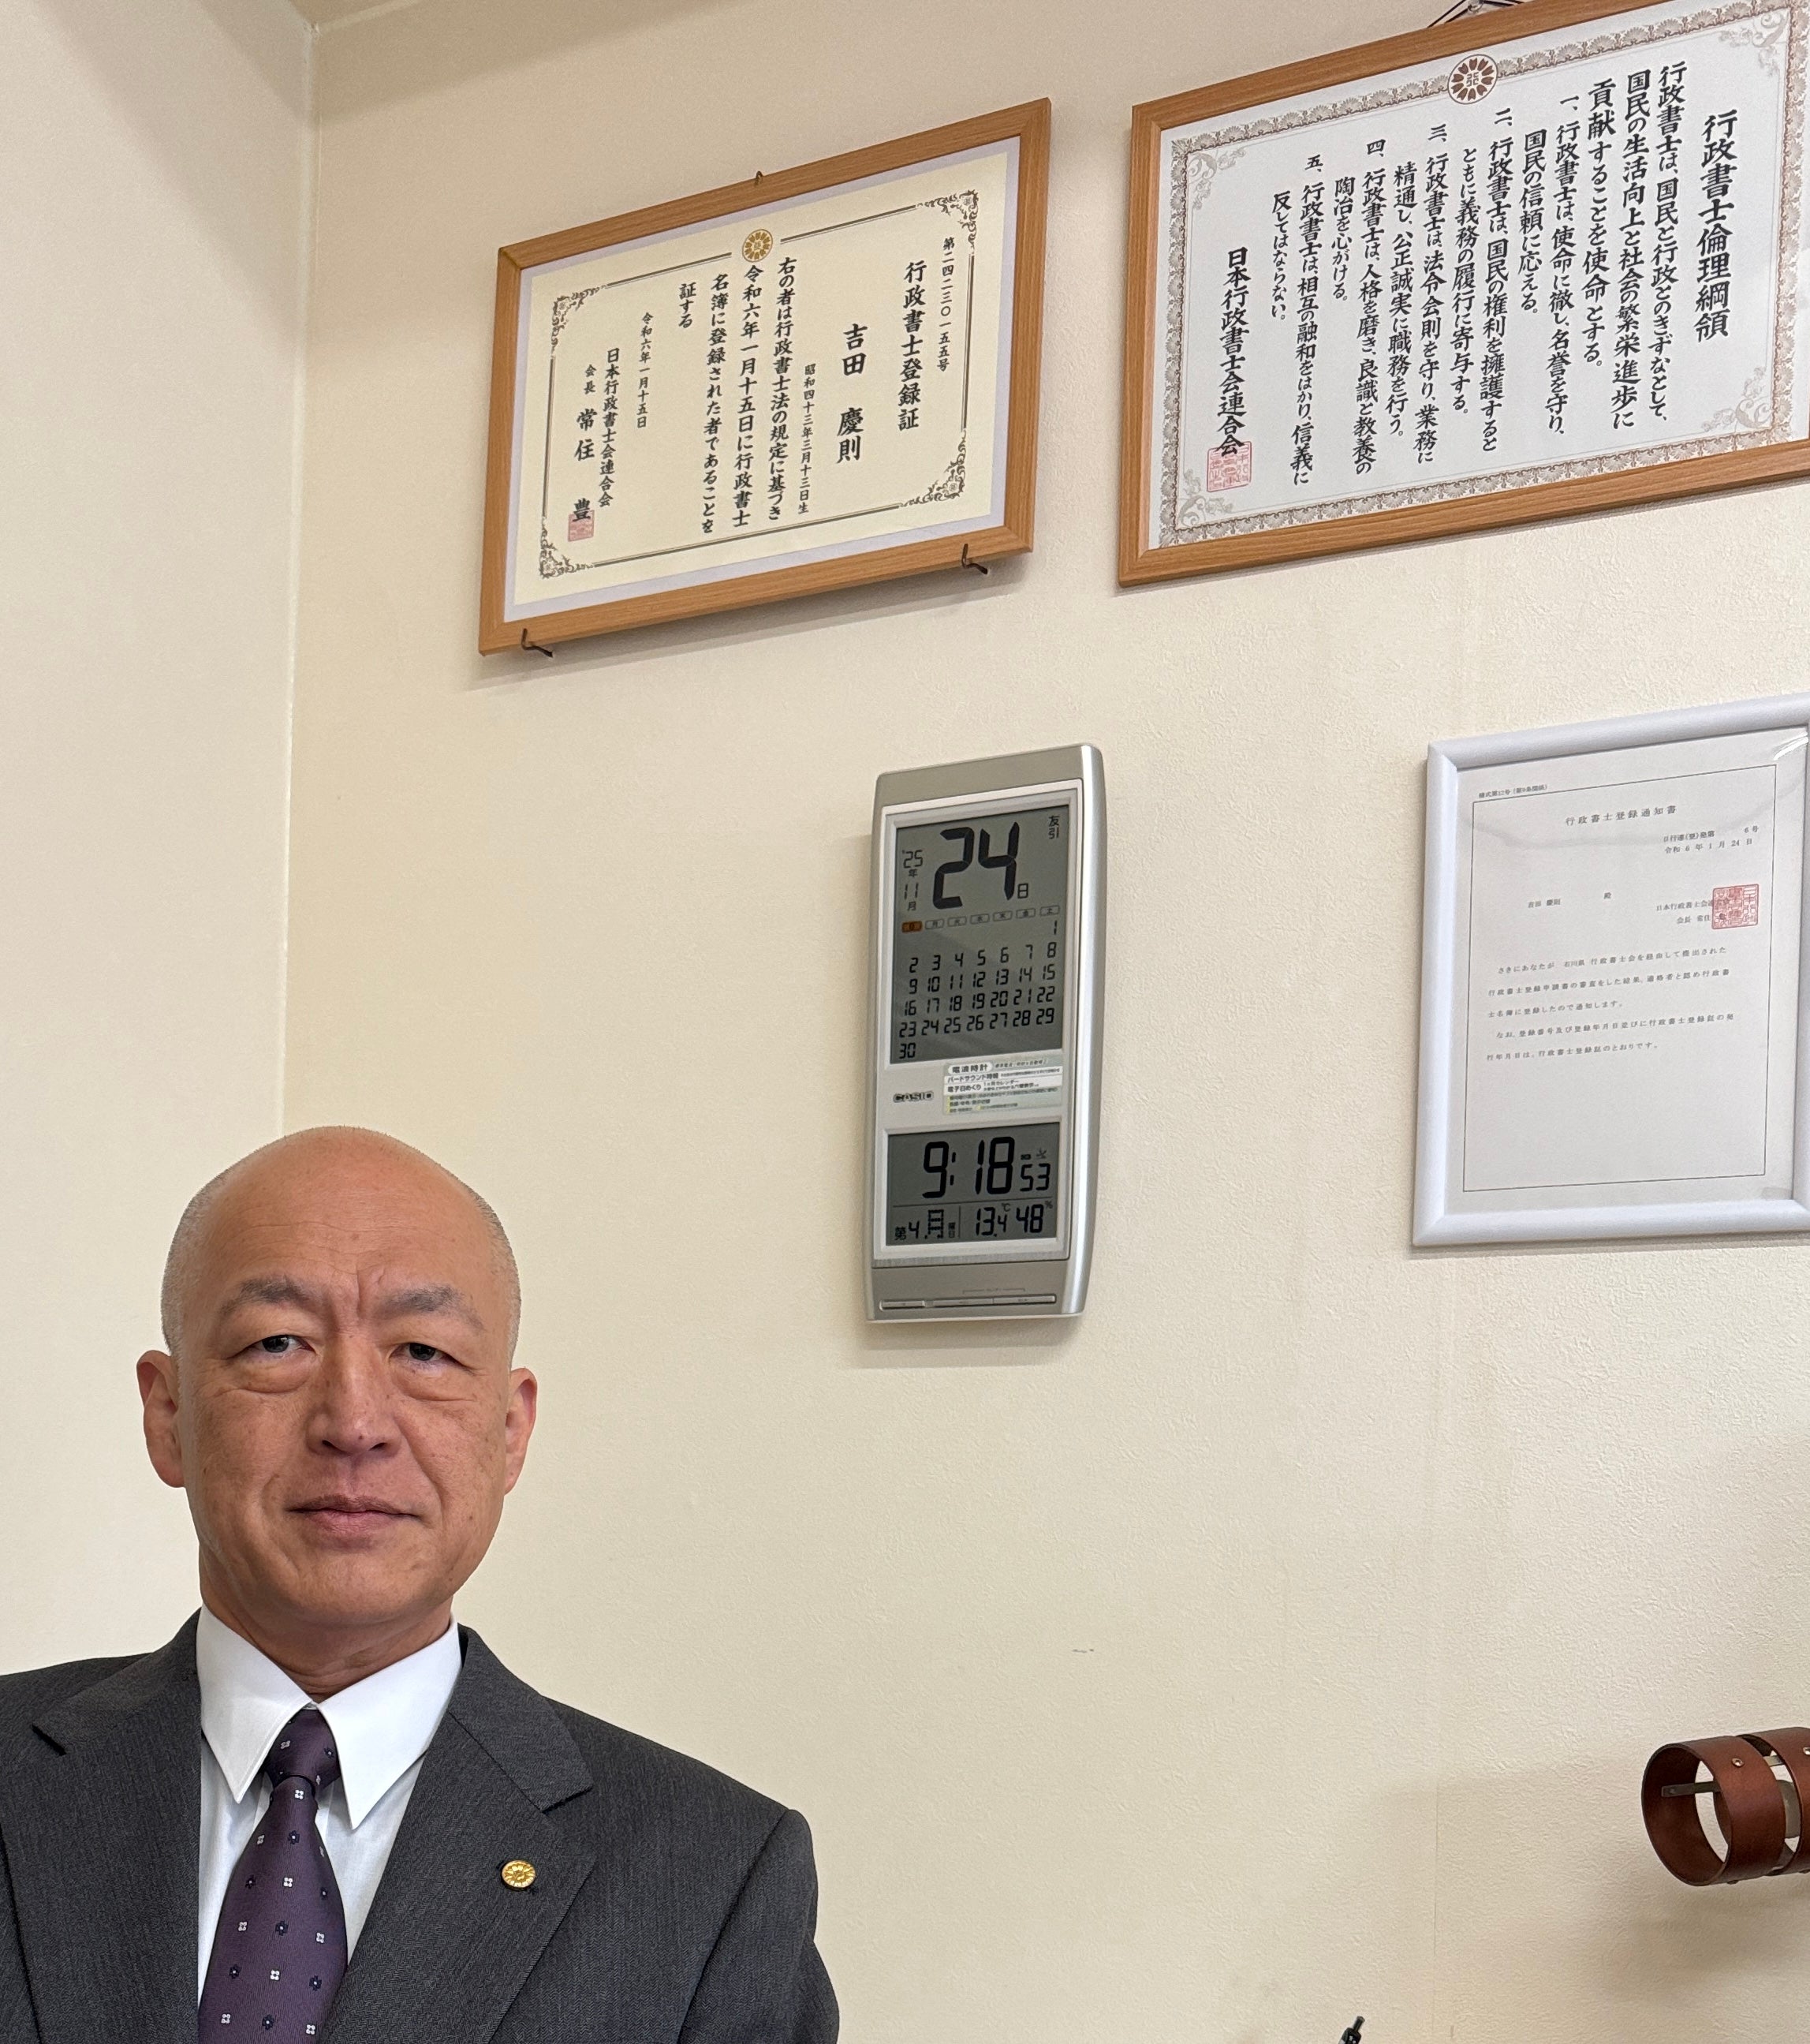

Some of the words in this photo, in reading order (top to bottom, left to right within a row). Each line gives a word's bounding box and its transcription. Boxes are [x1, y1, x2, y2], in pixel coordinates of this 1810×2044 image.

[1271, 190, 1293, 320] 反してはならない。
[1330, 175, 1356, 301] 陶冶を心がける。
[1517, 128, 1547, 314] 国民の信頼に応える。
[1581, 77, 1617, 367] 貢献することを使命とする。
[1612, 69, 1651, 430] 国民の生活向上と社会の繁栄進歩に
[1648, 61, 1688, 421] 行政書士は、国民と行政とのきずなとして、
[1693, 109, 1737, 342] 行政書士倫理綱領
[678, 282, 697, 329] 証する
[1384, 160, 1419, 437] 精通し、公正誠実に職務を行う。
[1450, 148, 1481, 414] ともに義務の履行に寄与する。
[584, 364, 597, 395] 会長
[636, 312, 654, 429] 令和六年一月十五日
[701, 274, 730, 534] 名簿に登録された者であることを
[732, 264, 764, 528] 令和六年一月十五日に行政書士
[768, 256, 797, 521] 右の者は行政書士法の規定に基づき
[842, 323, 868, 377] 吉田
[898, 260, 927, 432] 行政書士登録証
[1216, 246, 1252, 457] 日本行政書士会連合会
[599, 347, 621, 508] 日本行政書士会連合会
[797, 363, 816, 515] 昭和四十三年三月十三日生
[837, 407, 864, 465] 慶則
[904, 883, 920, 900] 11
[908, 901, 916, 911] 月
[933, 821, 1020, 909] 24
[909, 958, 918, 973] 2
[932, 955, 940, 970] 3
[955, 953, 963, 966] 4
[977, 950, 985, 966] 5
[1000, 947, 1009, 963] 6
[1026, 944, 1033, 959] 7
[1047, 942, 1056, 958] 8
[909, 979, 917, 994] 9
[928, 977, 940, 992] 10
[950, 974, 963, 989] 11
[973, 972, 985, 987] 12
[996, 969, 1009, 985] 13
[1019, 967, 1032, 982] 14
[1043, 964, 1055, 980] 15
[1054, 921, 1057, 934] 1
[899, 1022, 916, 1037] 23
[922, 1020, 939, 1035] 24
[944, 1017, 961, 1033] 25
[967, 1015, 983, 1031] 26
[990, 1012, 1007, 1029] 27
[1013, 1011, 1031, 1026] 28
[1036, 1008, 1054, 1025] 29
[900, 1043, 916, 1059] 30
[905, 1000, 916, 1015] 16
[927, 998, 939, 1013] 17
[950, 996, 962, 1011] 18
[972, 993, 985, 1009] 19
[991, 991, 1008, 1007] 20
[1013, 989, 1032, 1005] 21
[1037, 986, 1054, 1003] 22
[893, 1091, 934, 1103] CASIO
[922, 1136, 1016, 1199] 9:18
[1020, 1163, 1051, 1192] 53
[1016, 1204, 1044, 1233] 48
